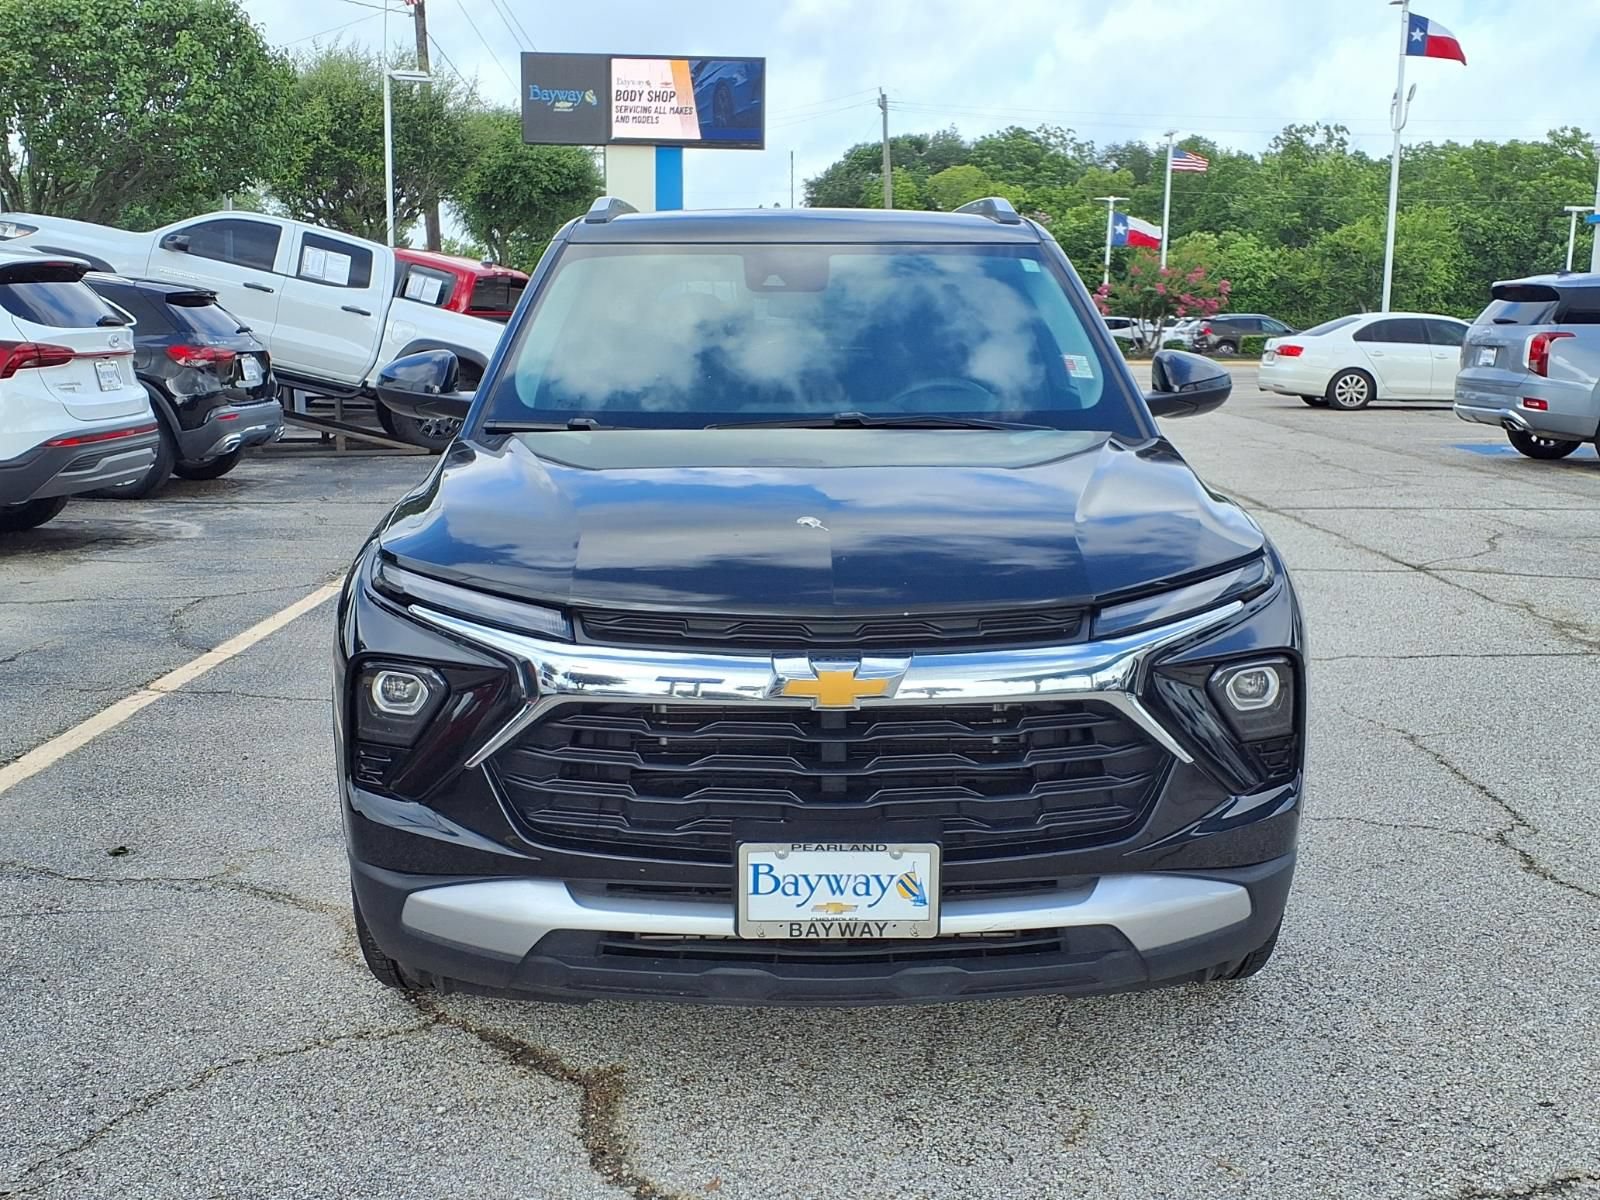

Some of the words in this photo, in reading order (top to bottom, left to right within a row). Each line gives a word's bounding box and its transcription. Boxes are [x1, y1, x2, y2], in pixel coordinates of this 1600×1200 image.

[528, 84, 584, 107] Bayway
[615, 89, 644, 102] BODY
[647, 90, 676, 103] SHOP
[615, 105, 652, 114] SERVICING
[653, 106, 667, 115] ALL
[669, 106, 694, 115] MAKES
[615, 115, 630, 124] AND
[631, 116, 660, 124] MODELS
[791, 843, 888, 852] PEARLAND
[748, 863, 898, 908] Bayway
[789, 922, 889, 938] BAYWAY
